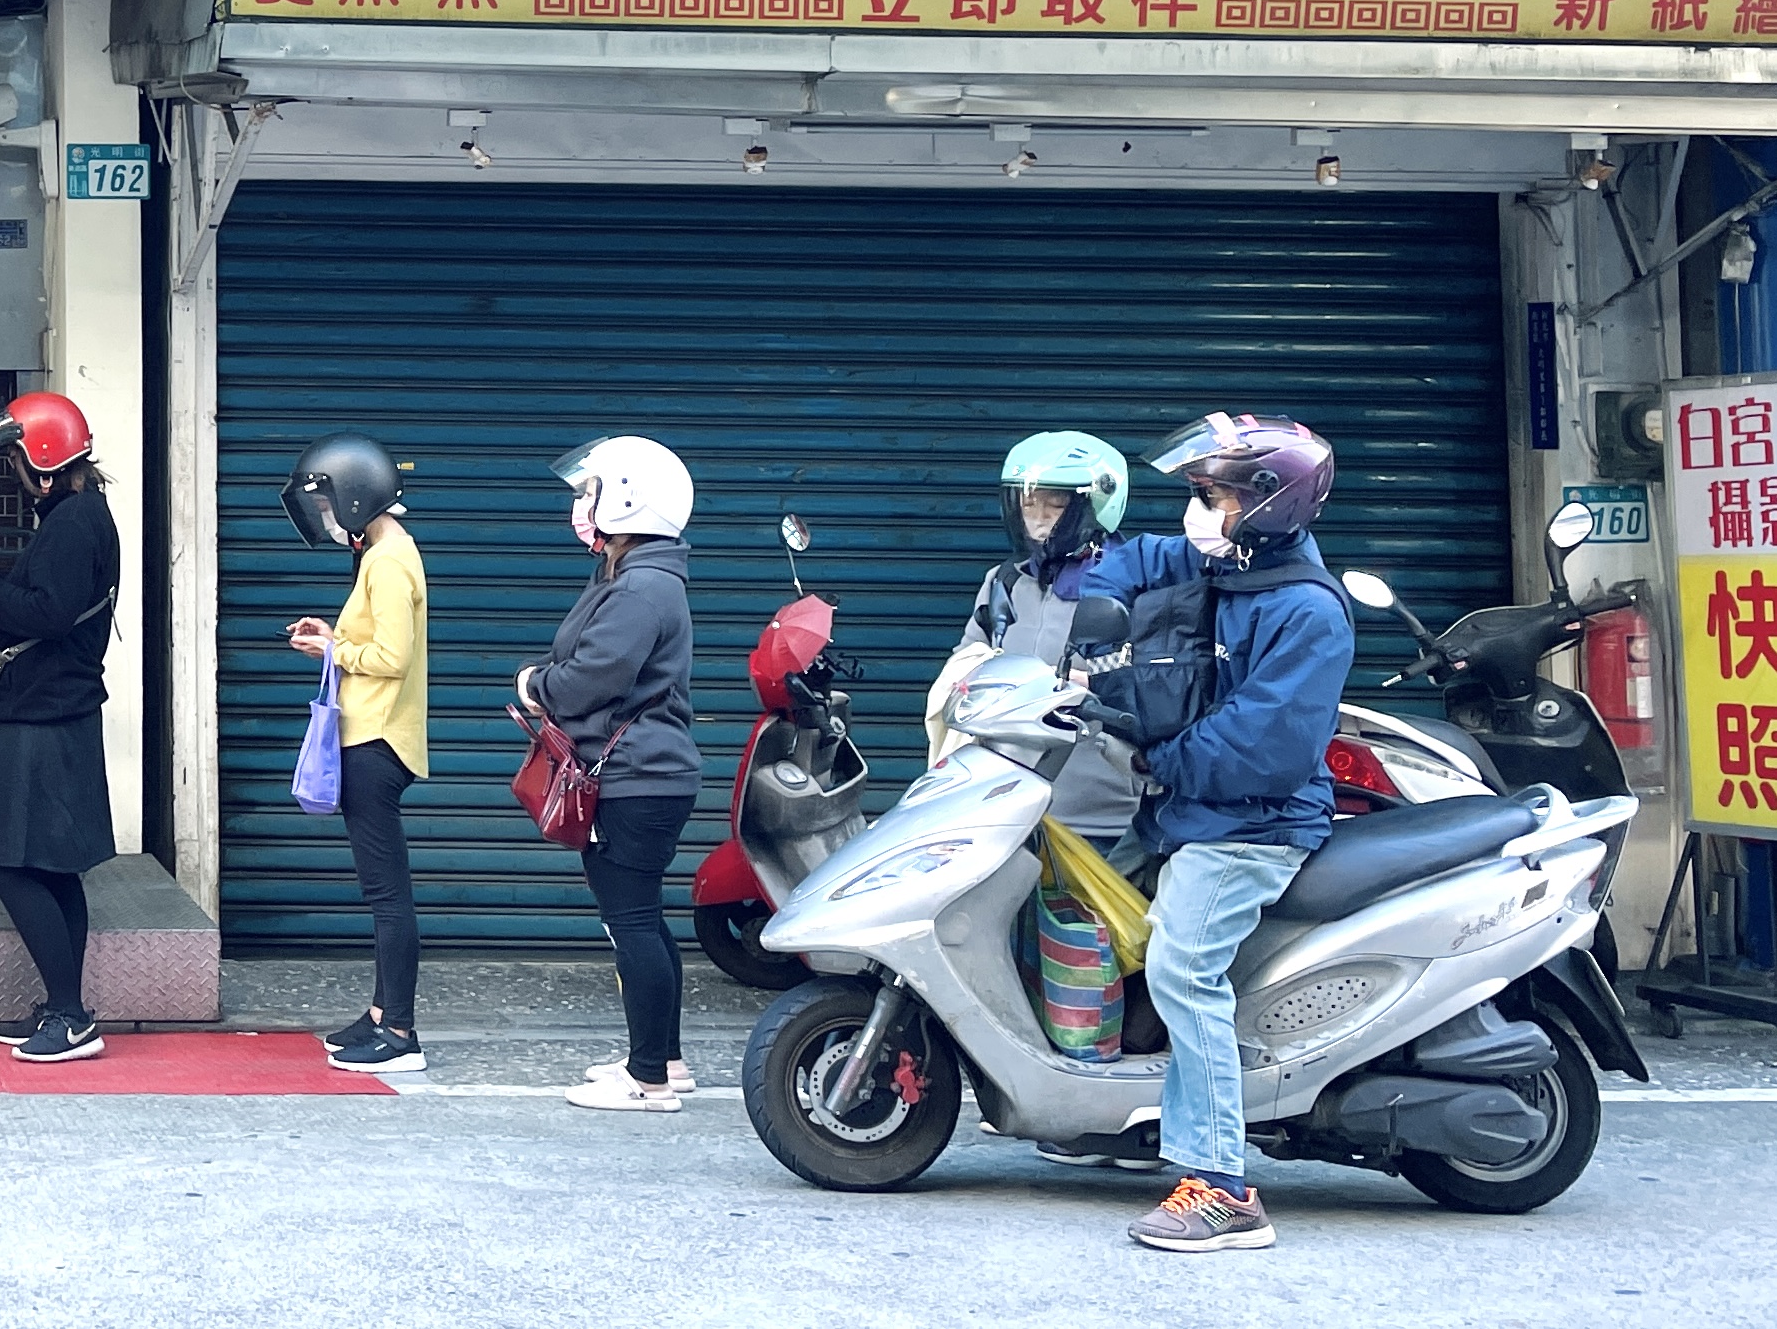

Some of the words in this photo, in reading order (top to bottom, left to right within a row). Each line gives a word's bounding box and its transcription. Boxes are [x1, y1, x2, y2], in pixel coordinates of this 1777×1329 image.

[94, 164, 144, 192] 162
[1676, 396, 1775, 471] 白宮
[1592, 506, 1642, 536] 160
[1706, 569, 1777, 810] 快照
